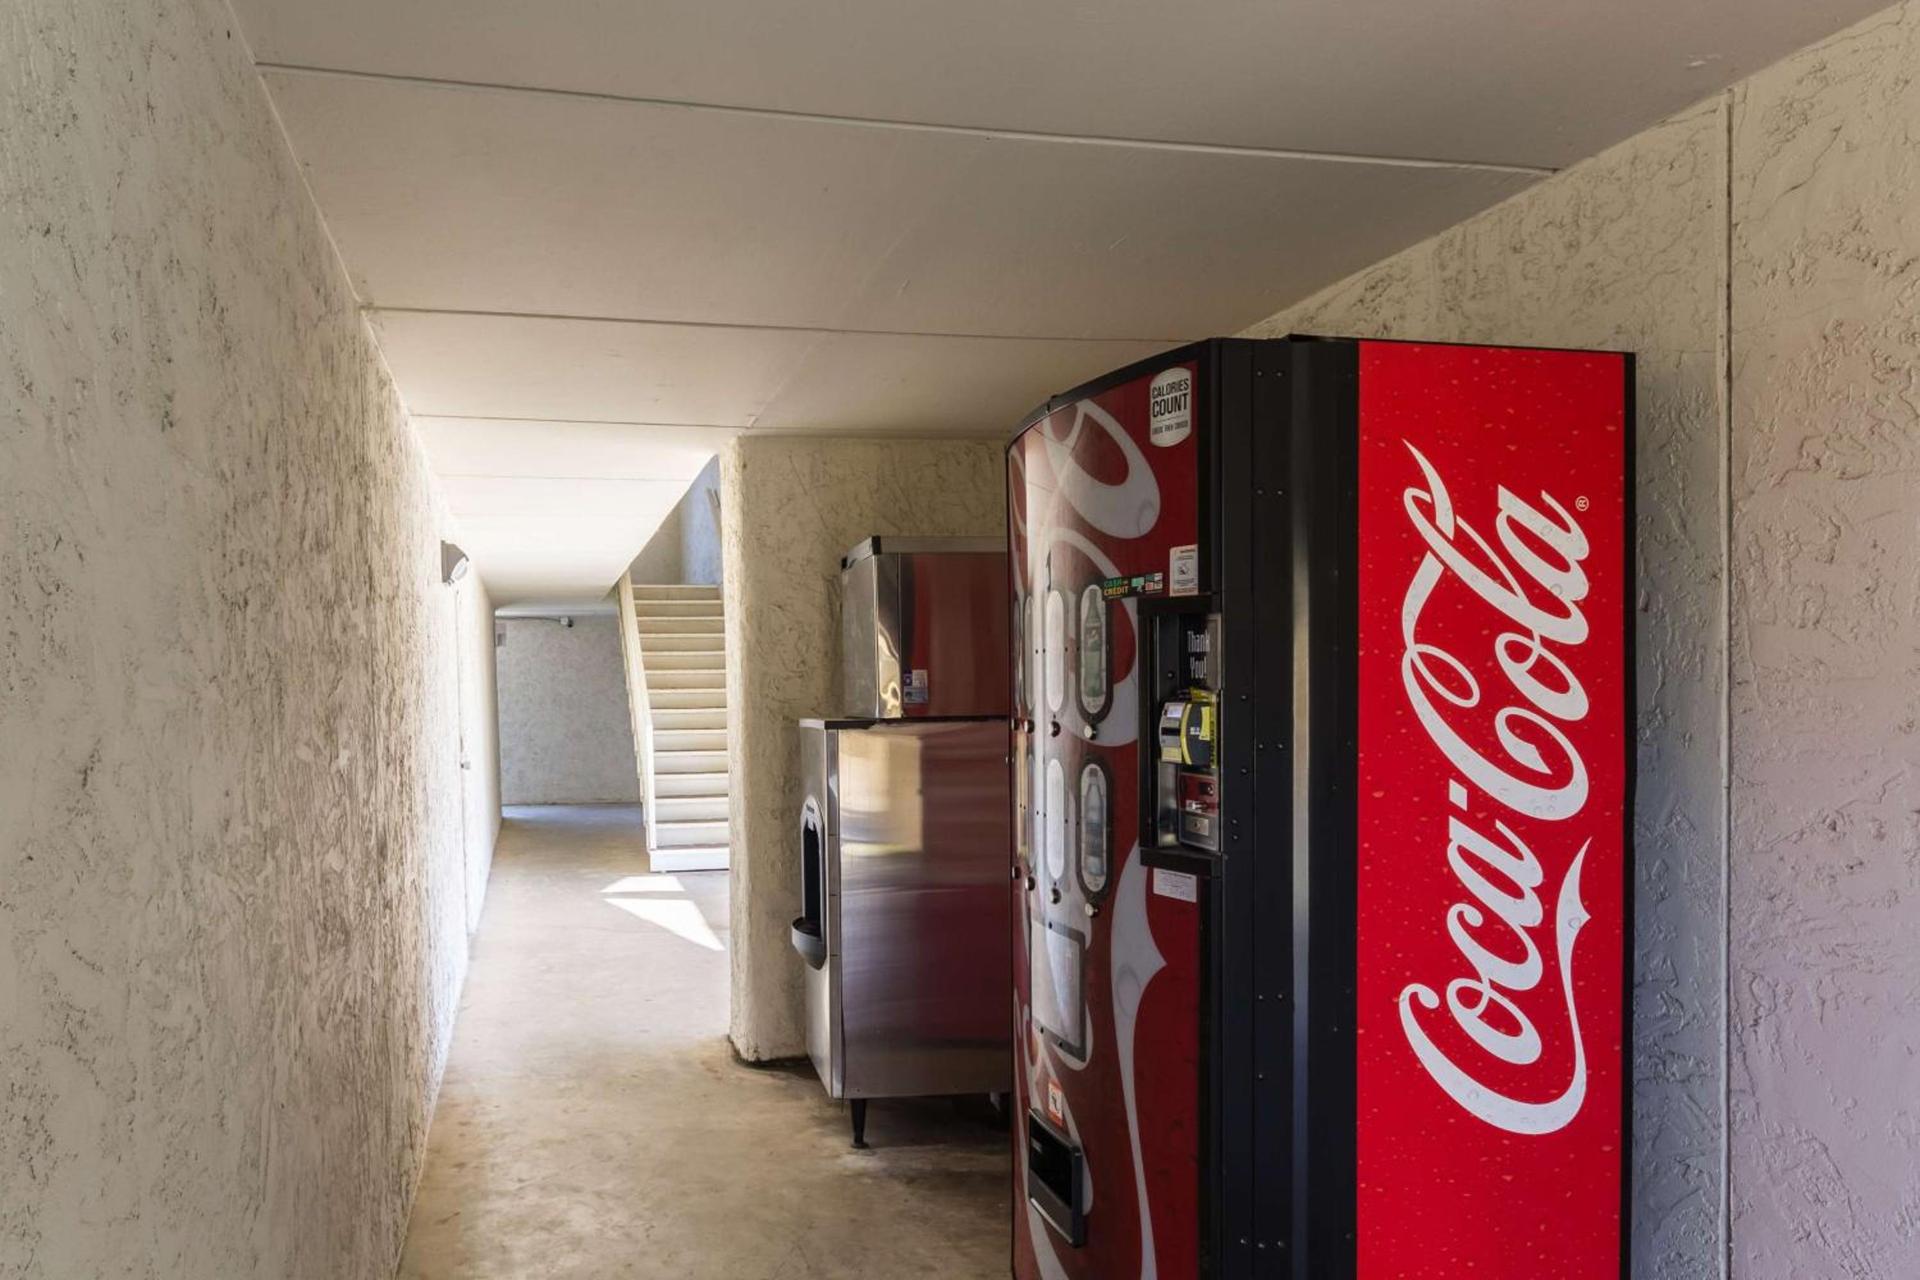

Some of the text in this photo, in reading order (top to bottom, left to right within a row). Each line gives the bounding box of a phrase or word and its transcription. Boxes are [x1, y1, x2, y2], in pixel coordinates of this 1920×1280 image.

[1152, 378, 1189, 399] CALORIES
[1152, 392, 1189, 417] COUNT
[1103, 585, 1129, 596] CREDIT
[1187, 629, 1210, 652] Thank
[1399, 438, 1592, 1136] Coca-Cola
